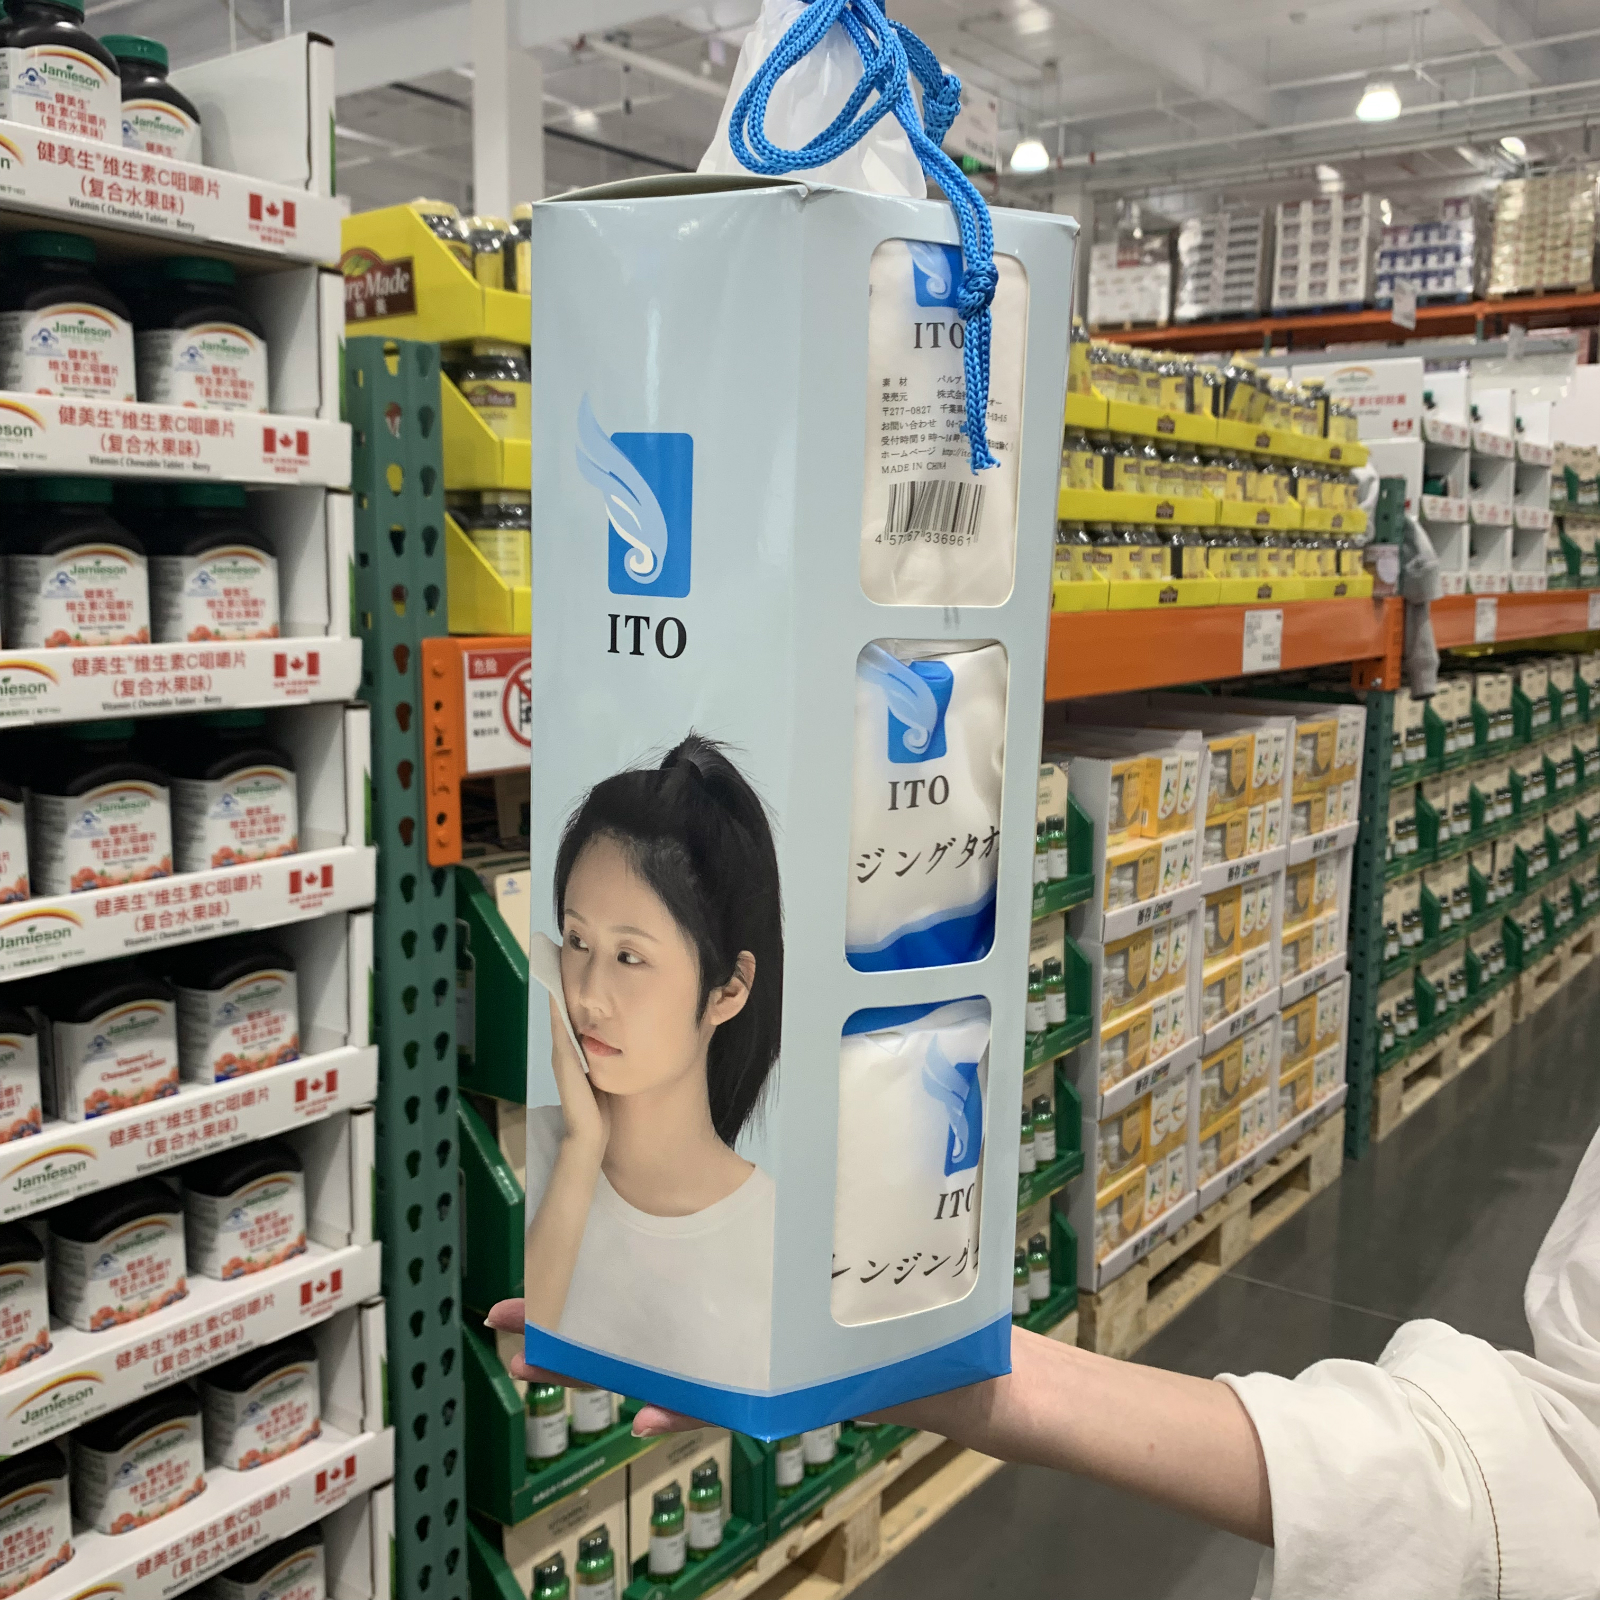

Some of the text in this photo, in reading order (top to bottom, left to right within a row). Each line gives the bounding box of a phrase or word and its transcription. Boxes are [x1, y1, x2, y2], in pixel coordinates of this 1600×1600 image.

[40, 63, 100, 89] Jamieson
[69, 197, 100, 213] Vitamin
[107, 204, 143, 221] Chewable
[146, 211, 168, 227] Tablet
[177, 217, 195, 232] Berry
[365, 266, 410, 299] Made
[940, 404, 966, 415] 千葉県
[881, 465, 910, 475] MADE
[912, 462, 923, 471] IN
[607, 613, 687, 659] ITO
[888, 775, 949, 811] ITO
[856, 825, 1000, 884] ジングタオ
[13, 1160, 87, 1191] Jamieson
[22, 1387, 94, 1425] Jamieson
